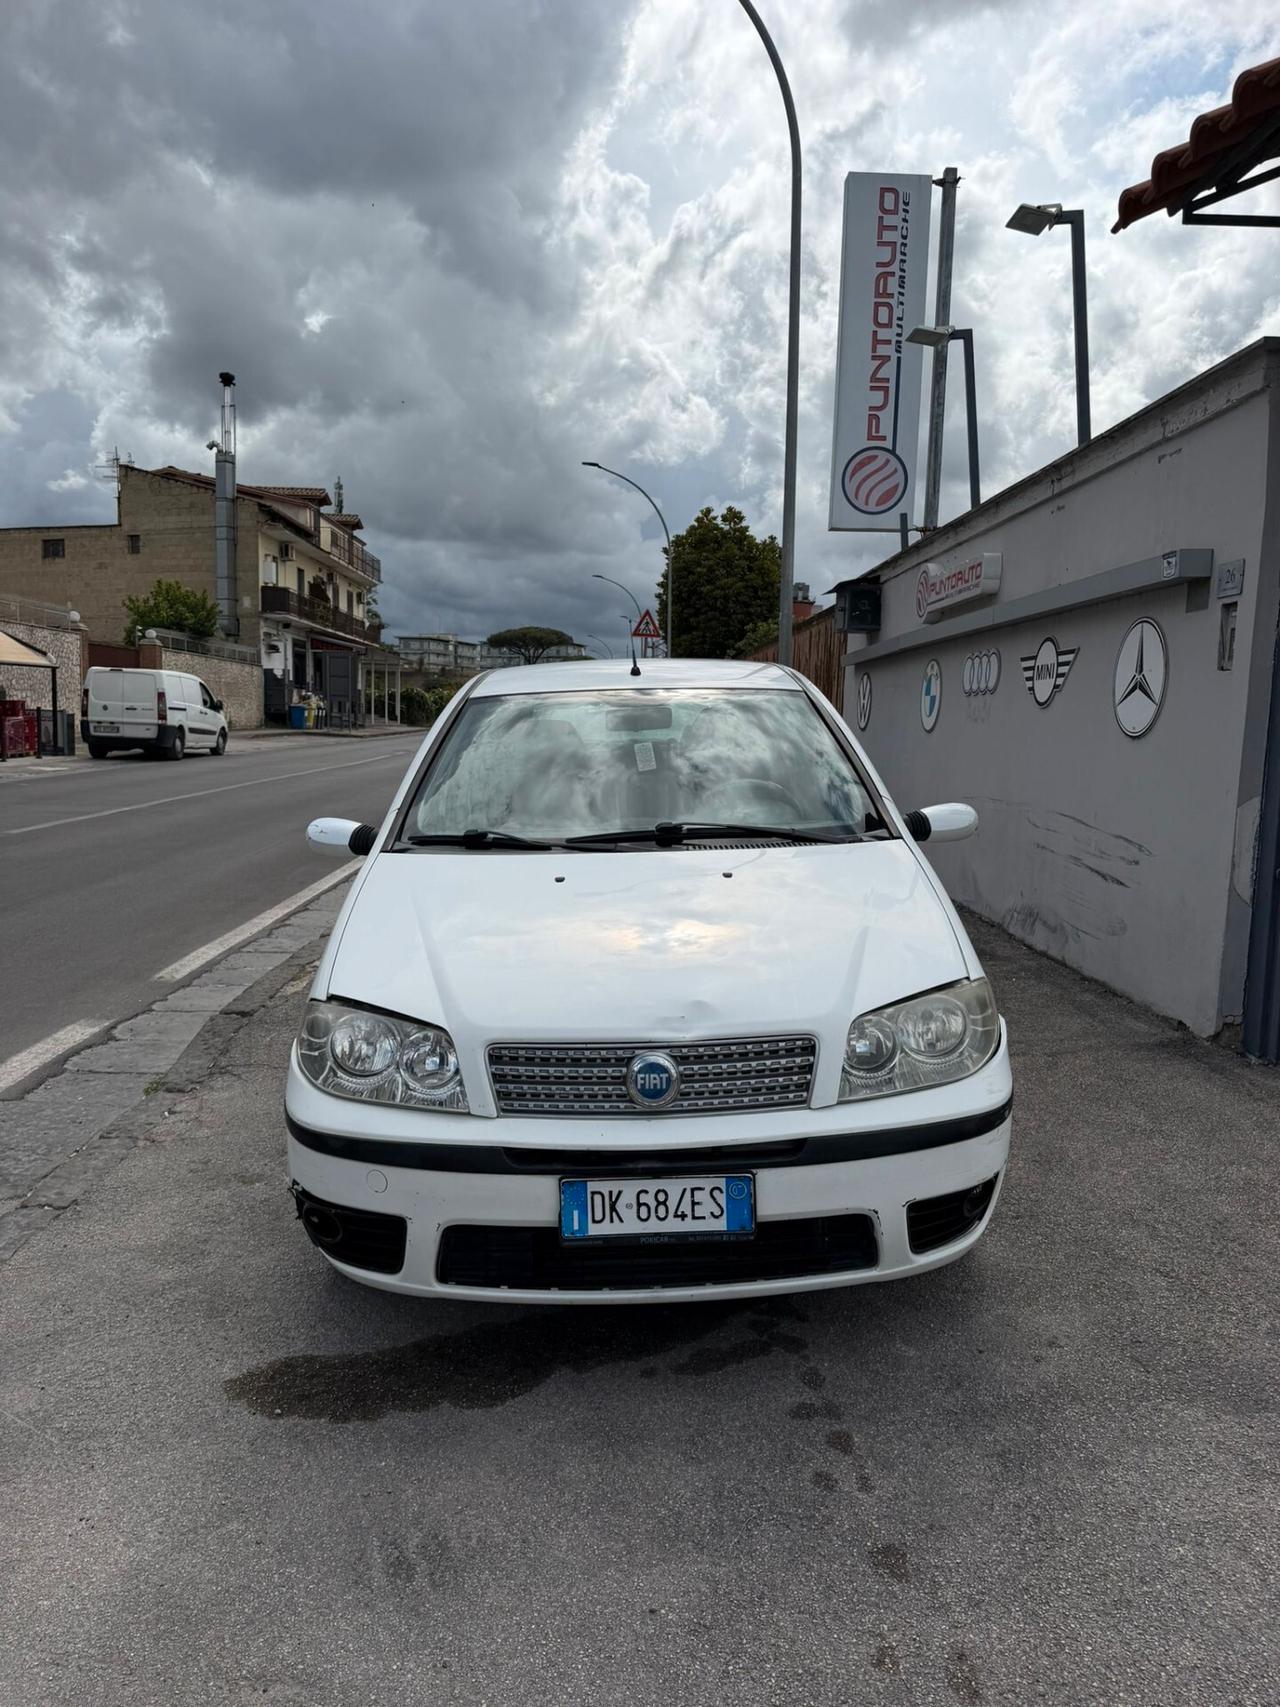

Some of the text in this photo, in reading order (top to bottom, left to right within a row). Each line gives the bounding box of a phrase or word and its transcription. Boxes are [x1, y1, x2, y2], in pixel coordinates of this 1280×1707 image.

[894, 191, 911, 354] MULTIMARCHE
[867, 187, 900, 441] PUNTOAUTO
[928, 561, 983, 598] PUNTOAUTO
[1036, 662, 1055, 680] MINI
[637, 1073, 669, 1089] FIAT
[590, 1186, 725, 1224] DK 684ES
